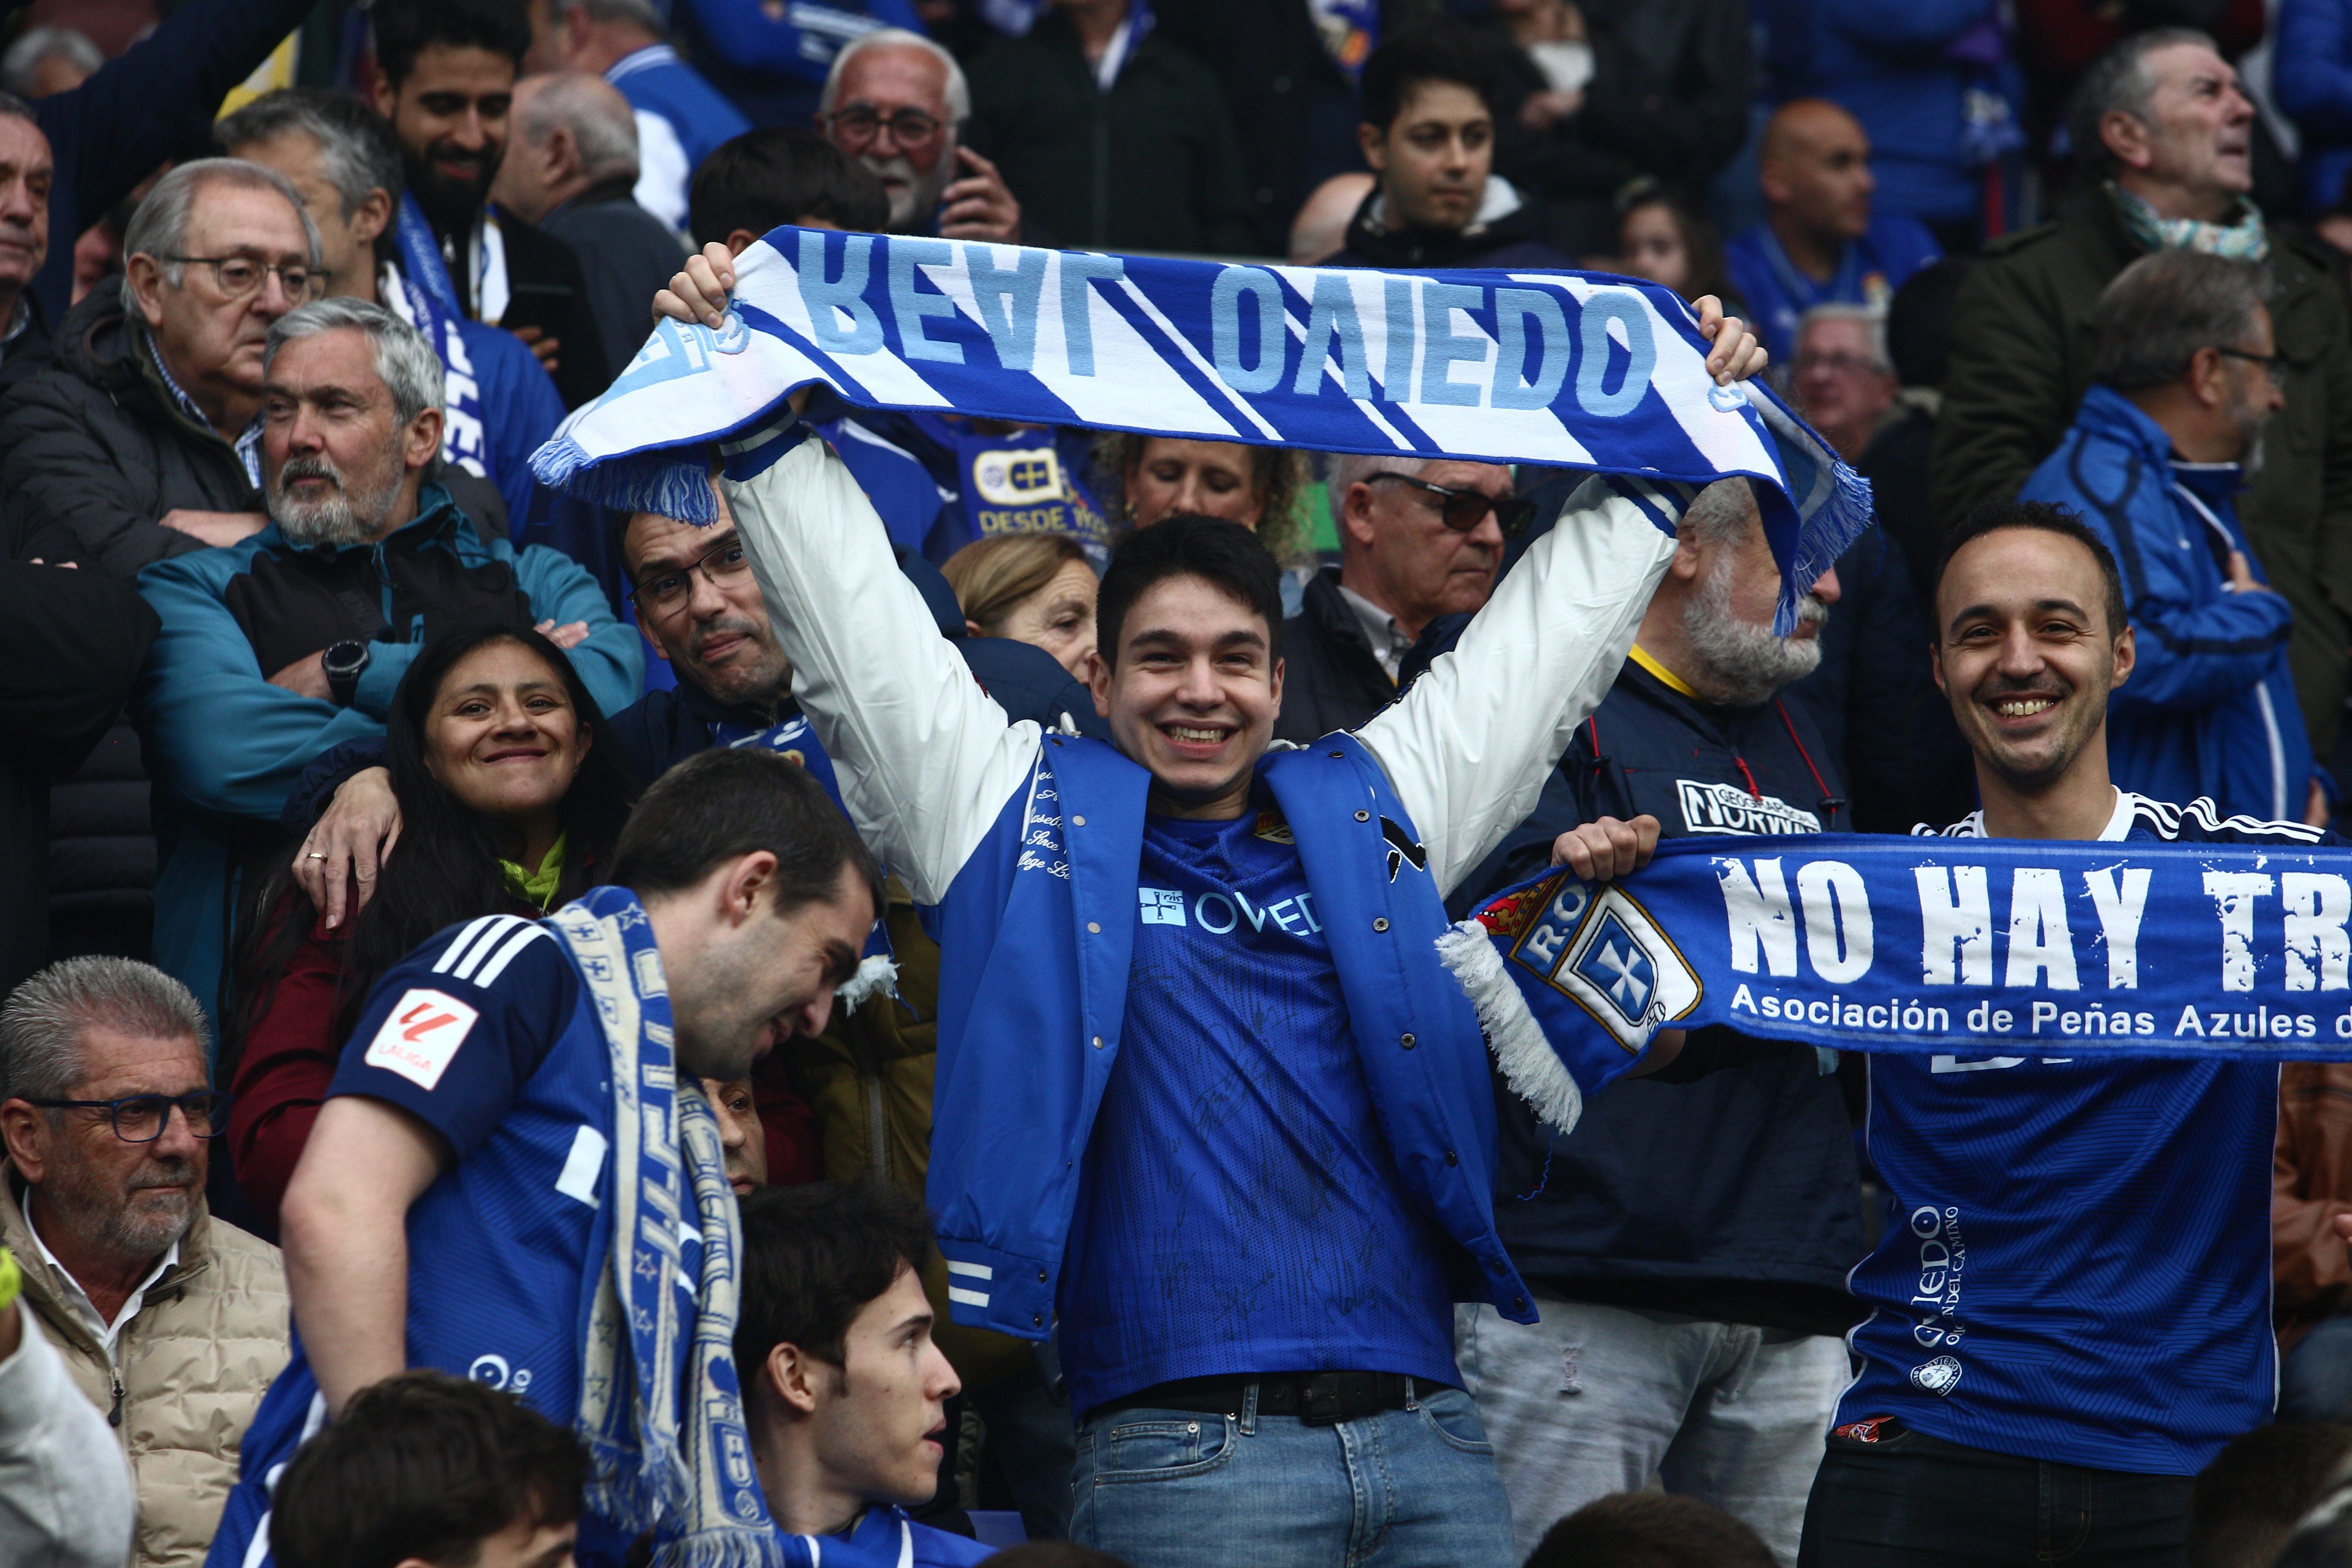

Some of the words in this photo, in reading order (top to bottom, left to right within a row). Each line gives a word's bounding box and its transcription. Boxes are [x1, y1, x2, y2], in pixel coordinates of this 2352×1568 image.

[978, 506, 1068, 533] DESDE
[1027, 830, 1059, 851] Since
[1713, 855, 1874, 984] NO
[1914, 861, 2153, 992] HAY
[1732, 983, 1949, 1032] Asociación
[1967, 1001, 2013, 1033] de
[2033, 1001, 2155, 1036] Peñas
[2174, 1004, 2317, 1038] Azules
[378, 1043, 433, 1073] LALIGA
[1945, 1206, 1966, 1272] CAMINO
